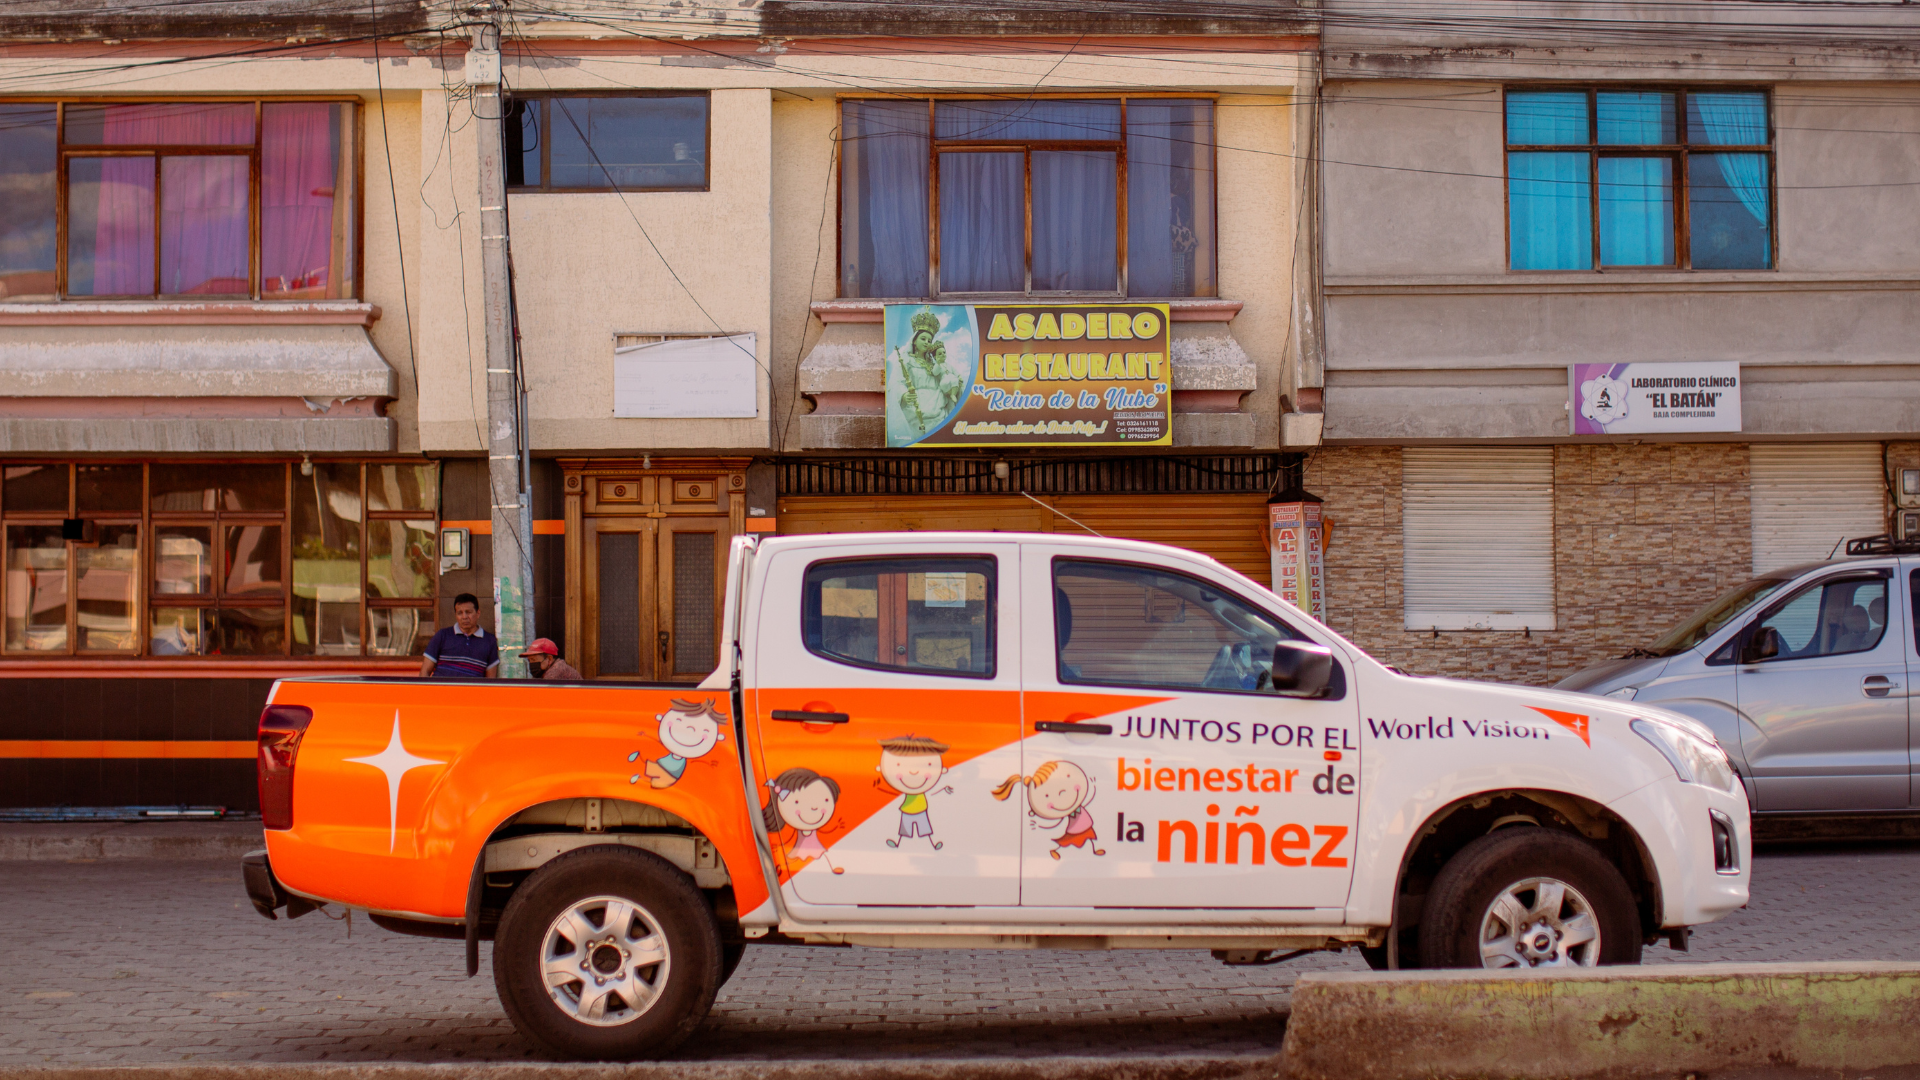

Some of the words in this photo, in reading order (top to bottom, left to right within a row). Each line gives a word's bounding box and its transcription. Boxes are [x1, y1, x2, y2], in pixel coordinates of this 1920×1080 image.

[988, 312, 1161, 341] ASADERO
[985, 353, 1164, 381] RESTAURANT
[1631, 377, 1698, 388] LABORATORIO
[1699, 375, 1736, 388] CLÍNICO
[1048, 389, 1074, 410] de
[1077, 388, 1099, 409] la
[1006, 420, 1034, 434] sabor
[1034, 420, 1047, 434] de
[1048, 420, 1074, 434] Doña
[1671, 410, 1716, 418] COMPLEJIDAD
[1119, 716, 1242, 744] JUNTOS
[1252, 723, 1313, 748] POR
[1324, 728, 1357, 751] EL
[1367, 716, 1454, 740] World
[1463, 718, 1550, 741] Vision
[1117, 757, 1299, 794] bienestar
[1312, 765, 1355, 795] de
[1116, 812, 1145, 842] la
[1157, 803, 1349, 869] niñez
